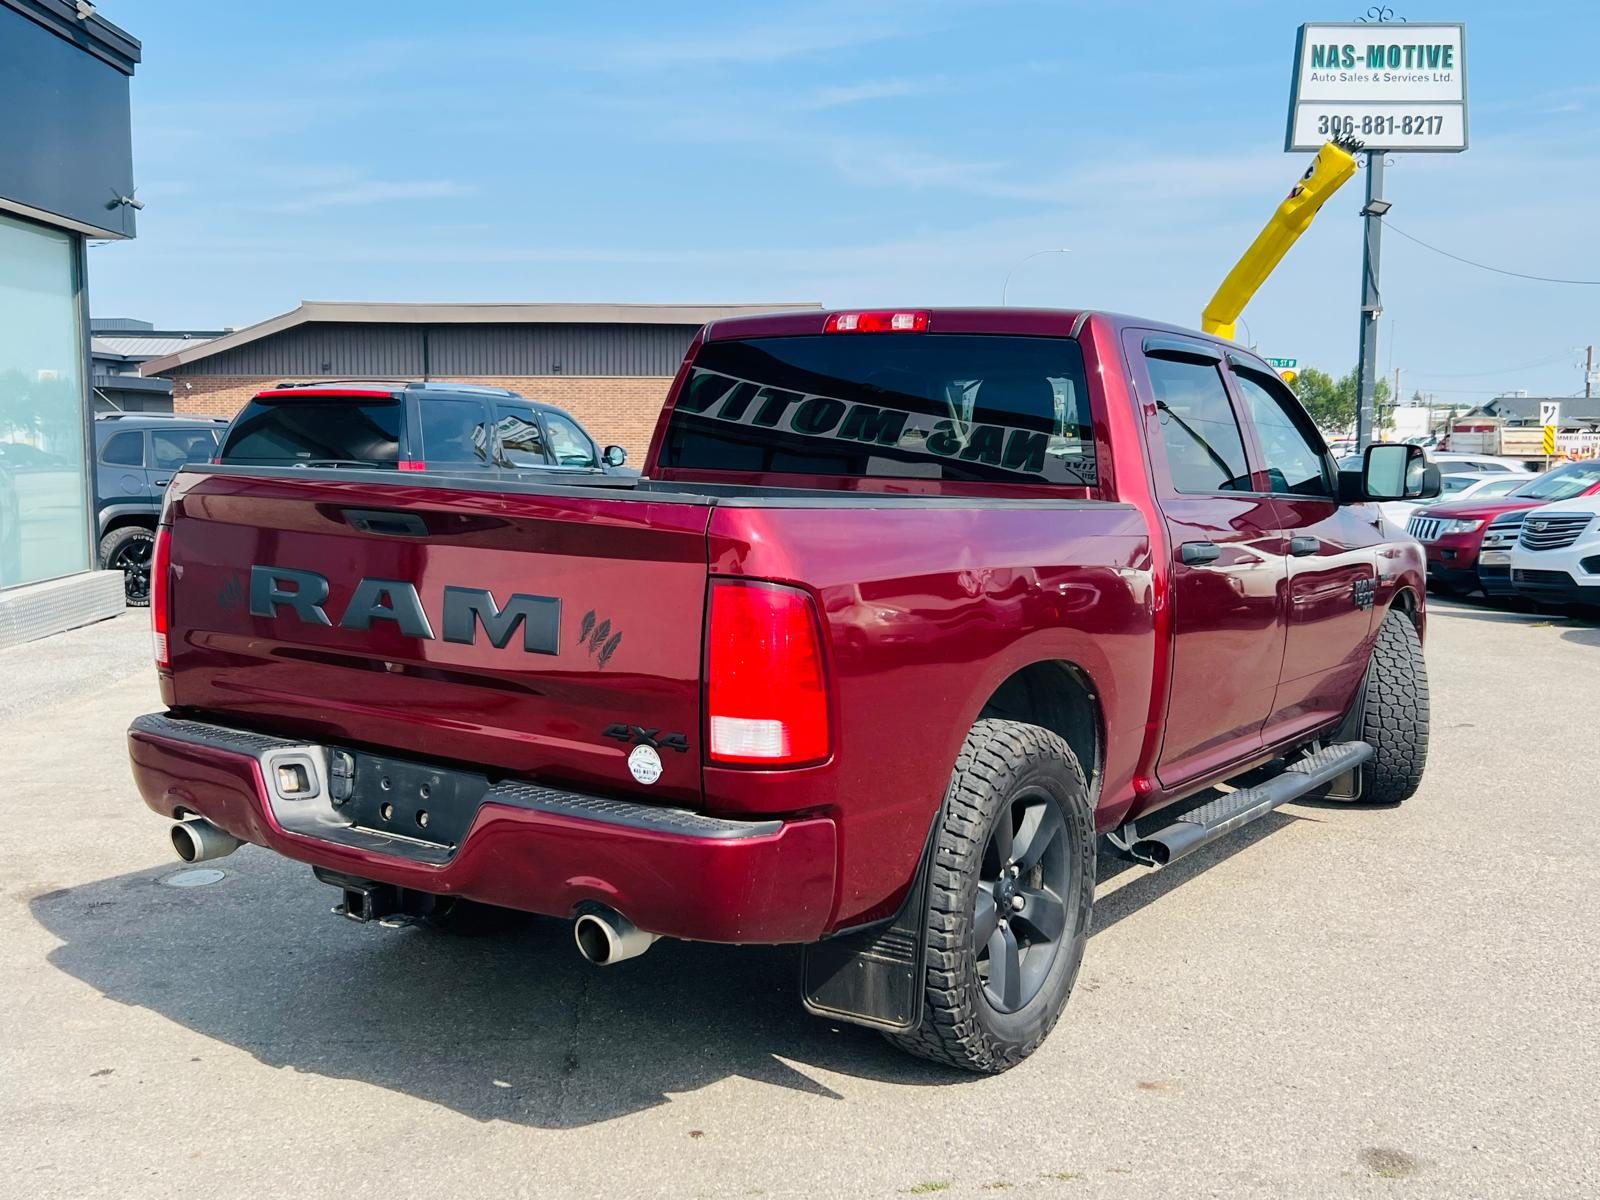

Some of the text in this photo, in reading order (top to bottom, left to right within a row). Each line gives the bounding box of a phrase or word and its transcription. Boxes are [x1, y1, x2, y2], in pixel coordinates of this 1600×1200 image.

[1311, 44, 1454, 69] NAS-MOTIVE
[1310, 72, 1454, 82] Auto Sales & Services Ltd.
[1318, 115, 1443, 135] 306-881-8217
[249, 565, 562, 656] RAM
